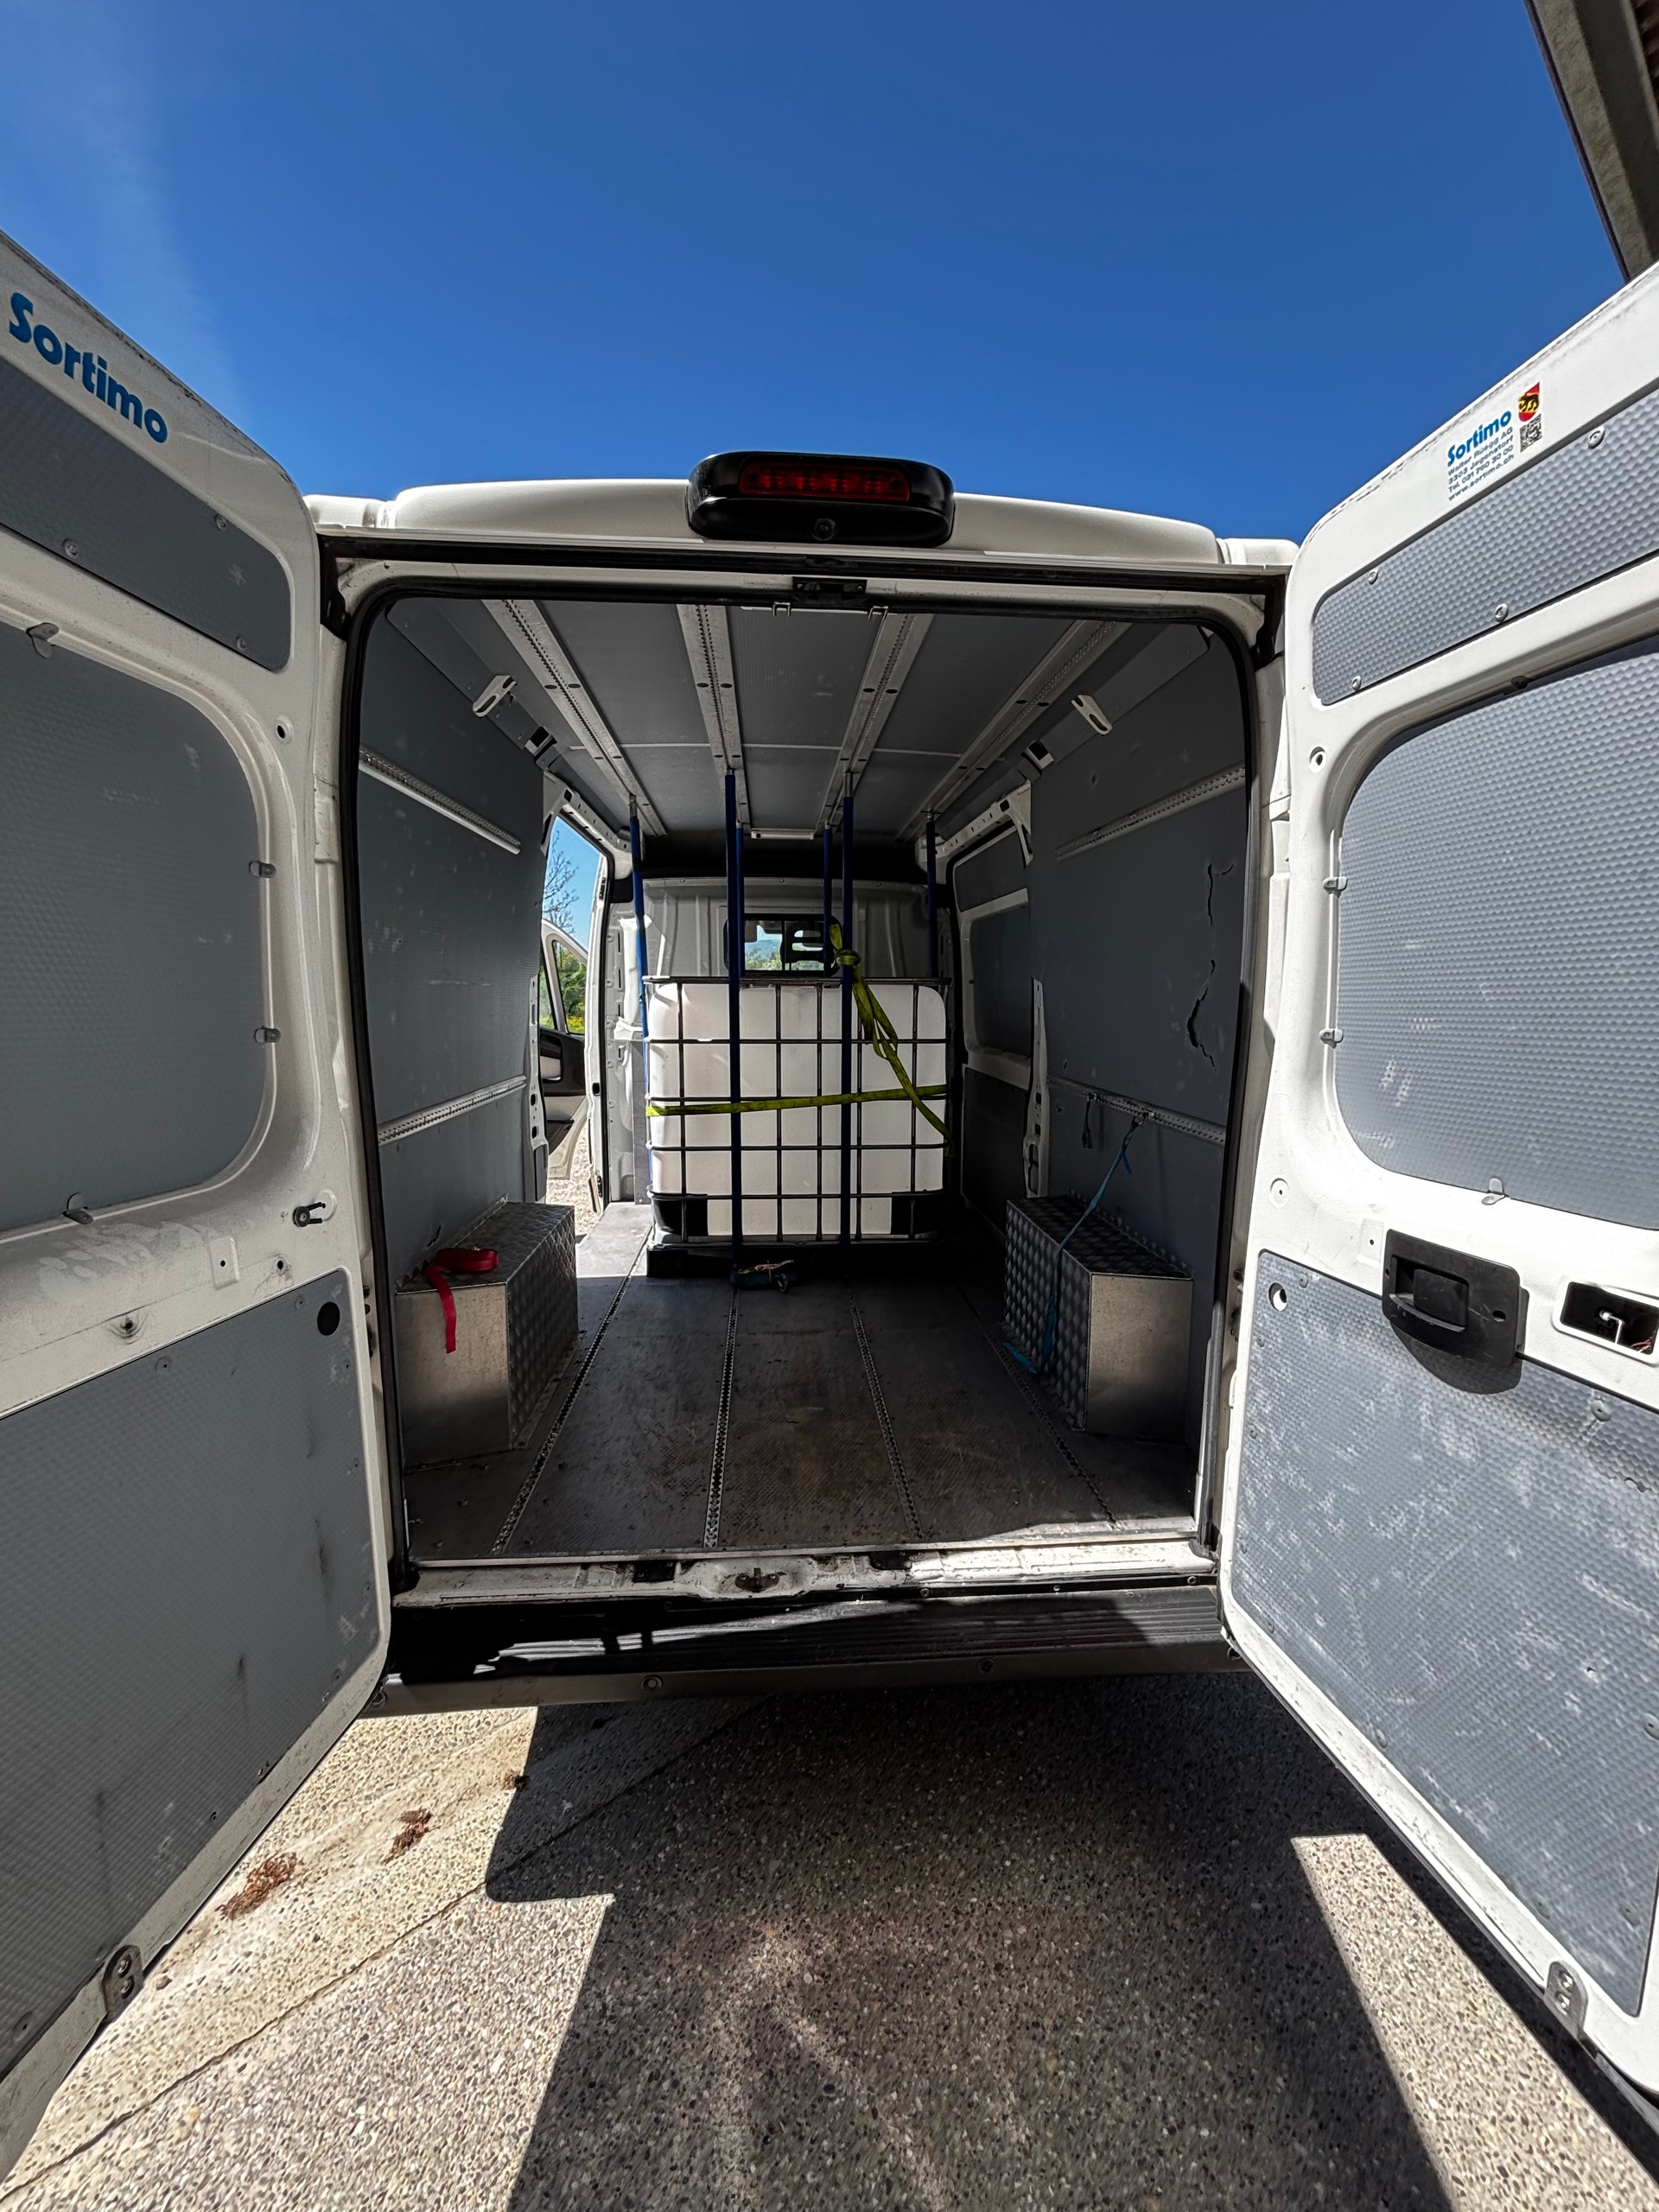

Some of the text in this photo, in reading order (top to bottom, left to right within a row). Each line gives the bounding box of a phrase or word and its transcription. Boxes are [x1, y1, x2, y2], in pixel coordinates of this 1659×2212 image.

[9, 292, 168, 443] Sortimo
[1447, 410, 1511, 467] Sortimo
[1448, 455, 1472, 476] Walter
[1501, 426, 1513, 440] AG
[1448, 435, 1514, 485] 3303 Jegenstorf
[1448, 454, 1514, 501] www.sortimo.ch
[1461, 471, 1474, 484] 031
[1491, 453, 1502, 464] 30
[1503, 444, 1514, 455] 00
